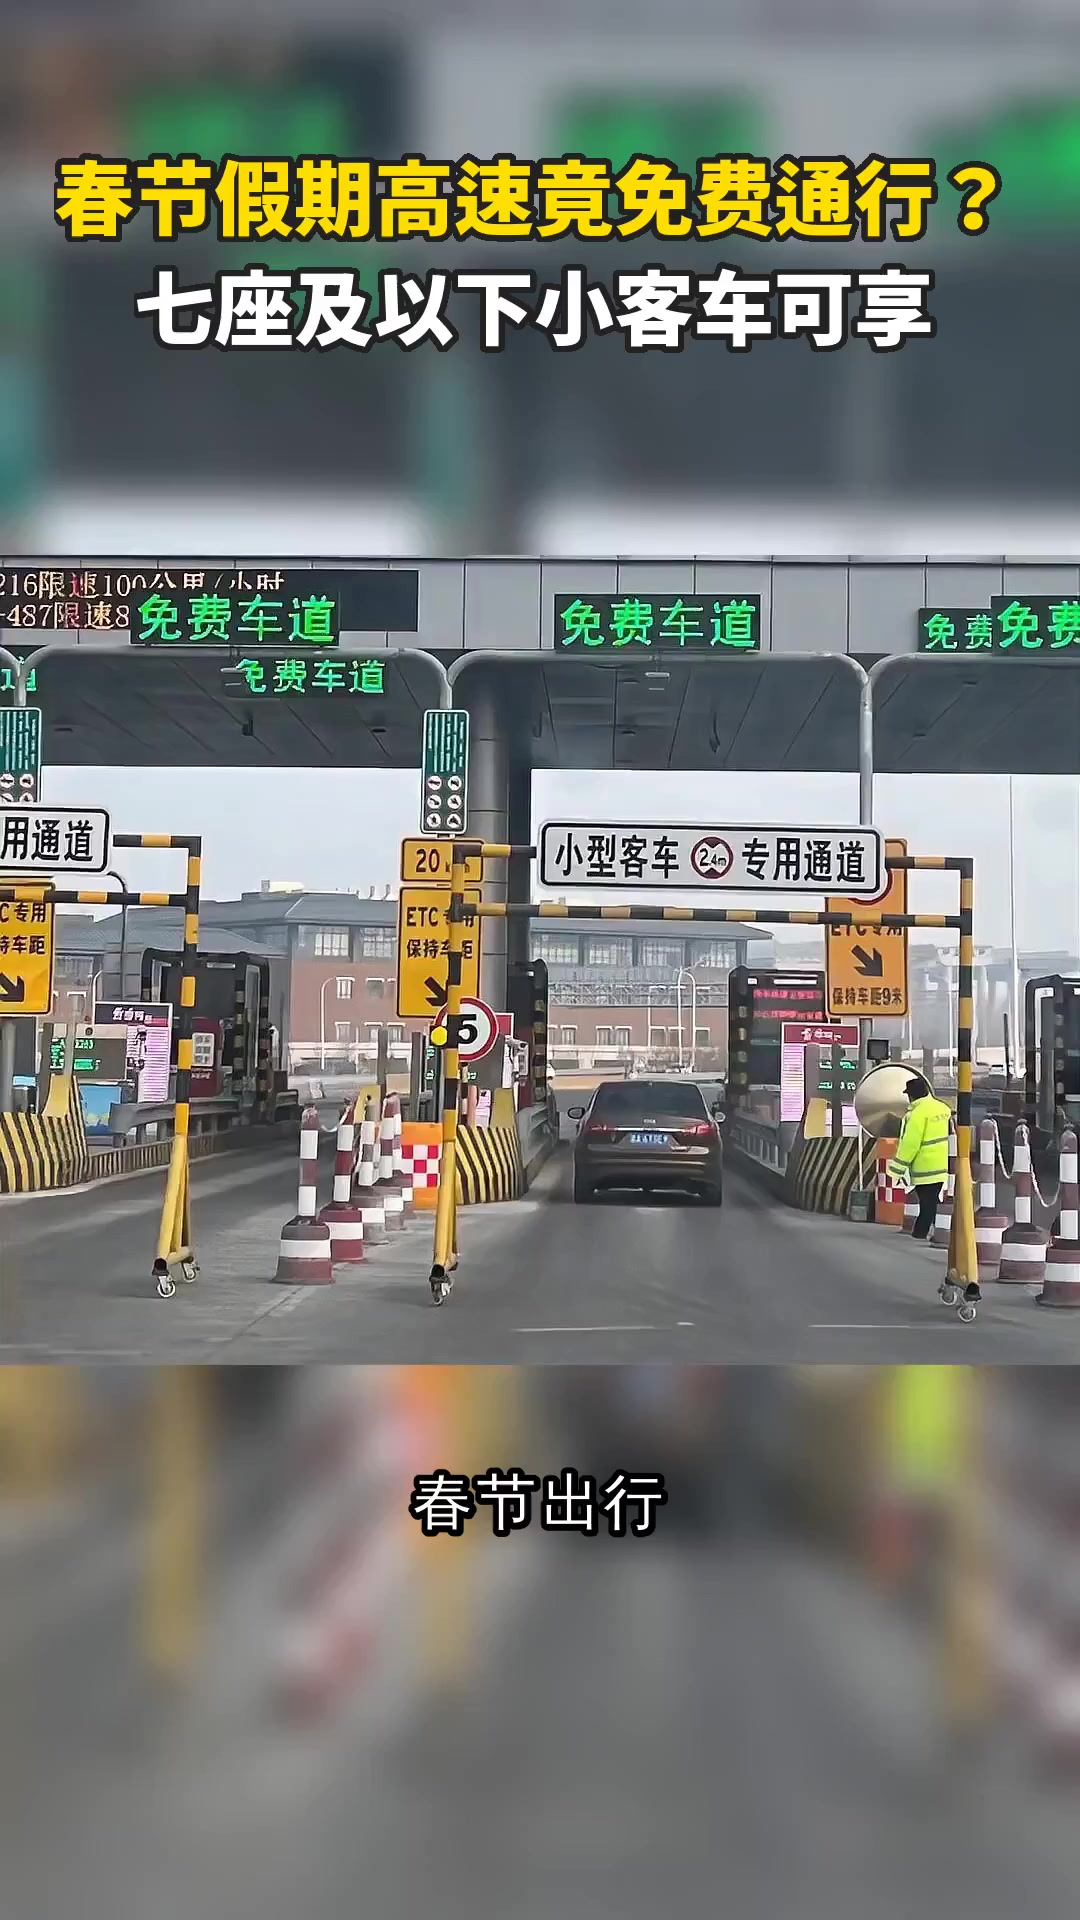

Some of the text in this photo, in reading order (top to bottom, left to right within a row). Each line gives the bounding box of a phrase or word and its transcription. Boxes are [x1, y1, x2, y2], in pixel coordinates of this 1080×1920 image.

[138, 593, 335, 642] 免费车道
[560, 598, 756, 647] 免费车道
[238, 659, 384, 694] 免费车道
[0, 816, 93, 862] 用通道
[555, 832, 680, 879] 小型客车
[741, 837, 866, 883] 专用通道
[415, 848, 440, 873] 20
[14, 902, 46, 922] 专用
[406, 906, 438, 928] ETC
